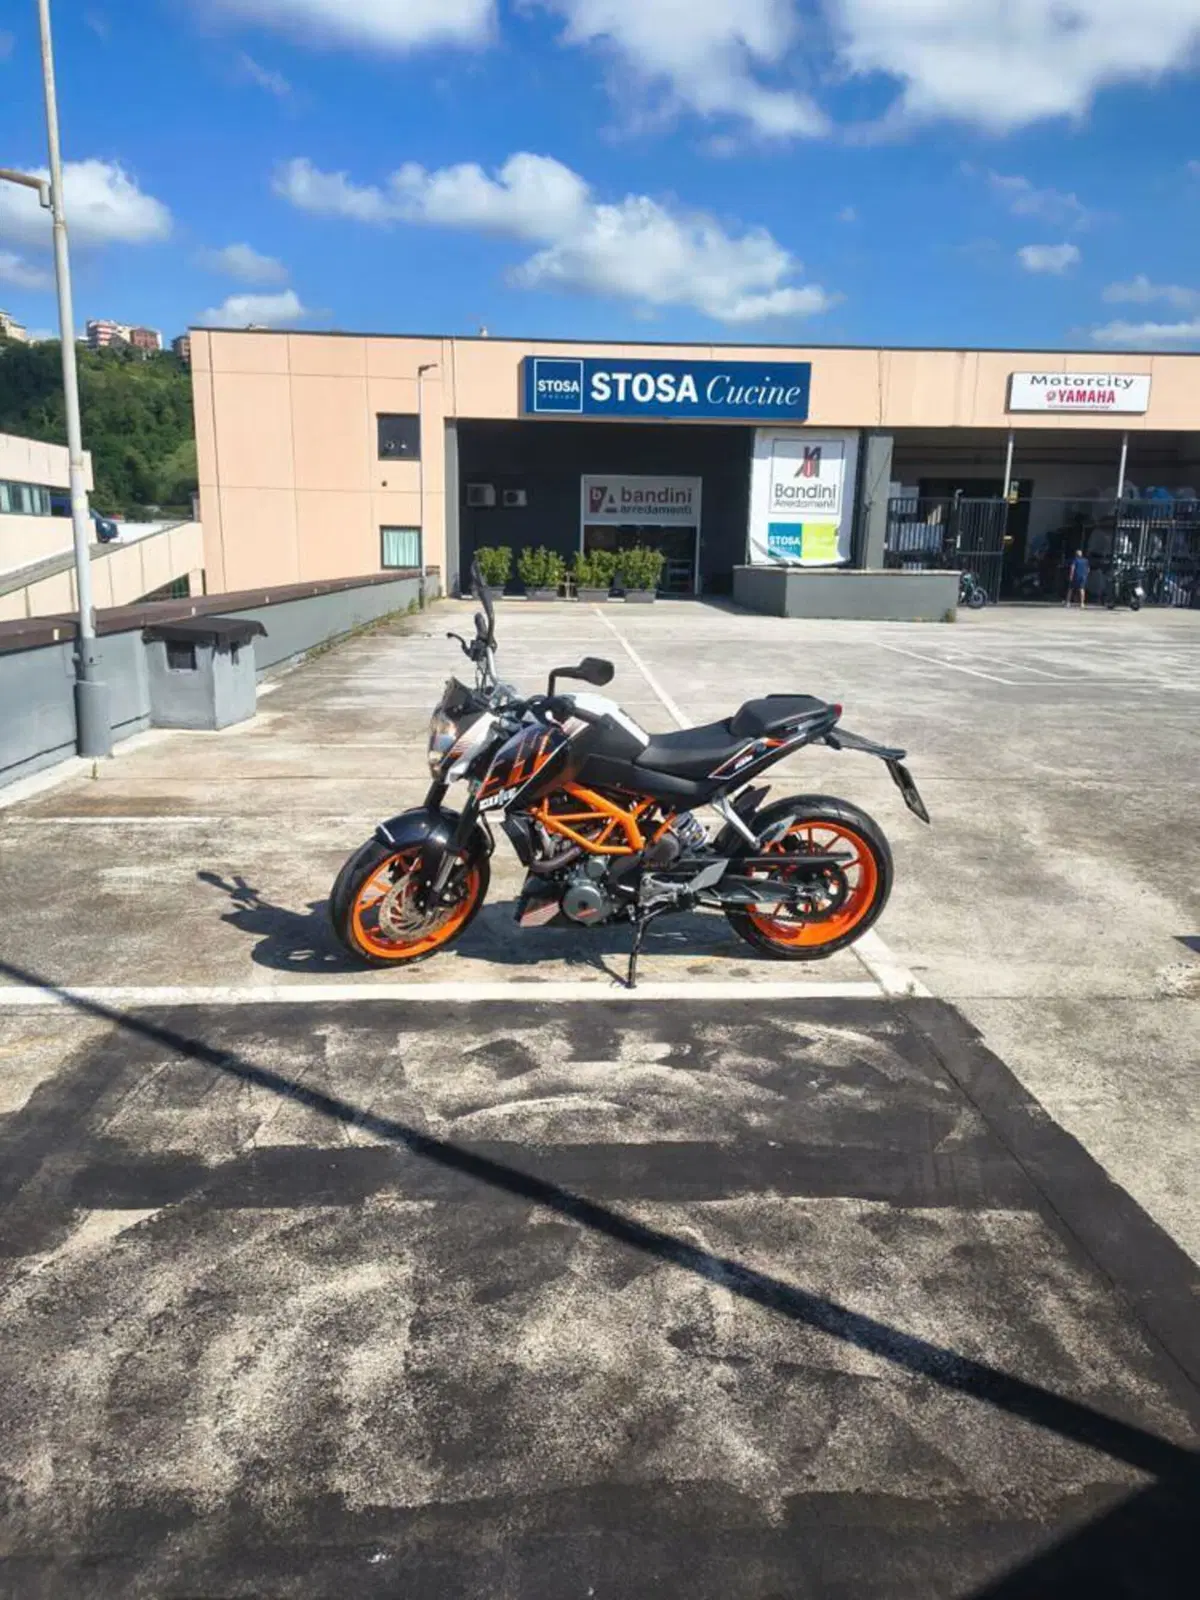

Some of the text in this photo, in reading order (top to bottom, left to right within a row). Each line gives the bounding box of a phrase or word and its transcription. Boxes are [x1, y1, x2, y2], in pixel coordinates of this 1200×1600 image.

[538, 379, 580, 393] STOSA
[591, 372, 801, 406] STOSA Cucine
[1030, 375, 1134, 390] Motorcity
[1059, 389, 1115, 403] YAMAHA
[621, 486, 692, 503] bandini
[775, 483, 836, 499] Bandini
